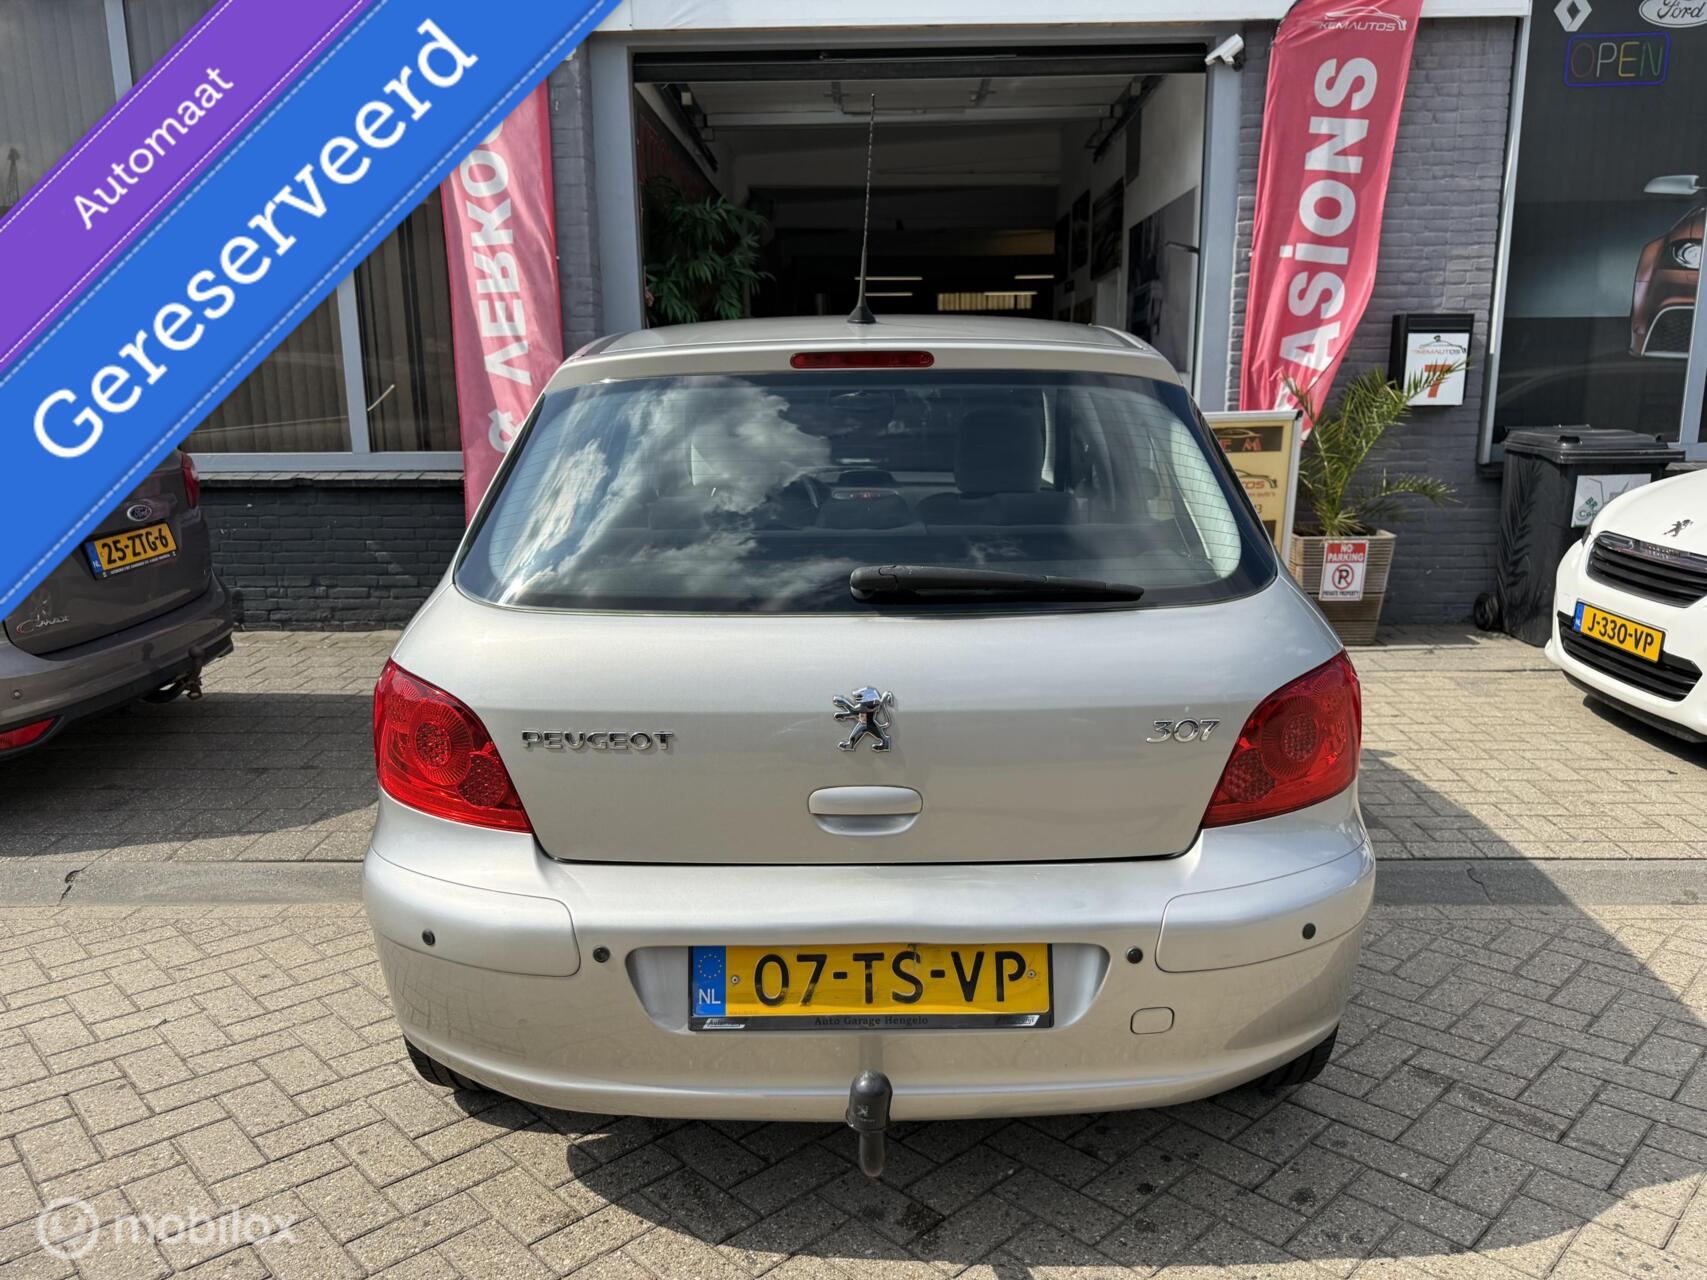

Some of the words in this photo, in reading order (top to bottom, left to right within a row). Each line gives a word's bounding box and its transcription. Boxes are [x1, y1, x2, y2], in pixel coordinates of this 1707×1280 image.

[1656, 0, 1705, 19] Ford
[1571, 41, 1664, 78] OPEN
[1424, 364, 1454, 398] 7
[101, 528, 169, 565] 25-ZTG-6
[1327, 552, 1364, 562] PARKING
[1340, 543, 1354, 552] NO
[1588, 613, 1654, 653] J-330-VP
[521, 730, 674, 751] PEUGEOT
[1146, 718, 1220, 742] 307
[753, 950, 1027, 1007] 07-TS-VP
[698, 988, 721, 1005] NL
[815, 1016, 840, 1025] Auto
[844, 1016, 880, 1027] Garage
[884, 1015, 929, 1027] Hengelo
